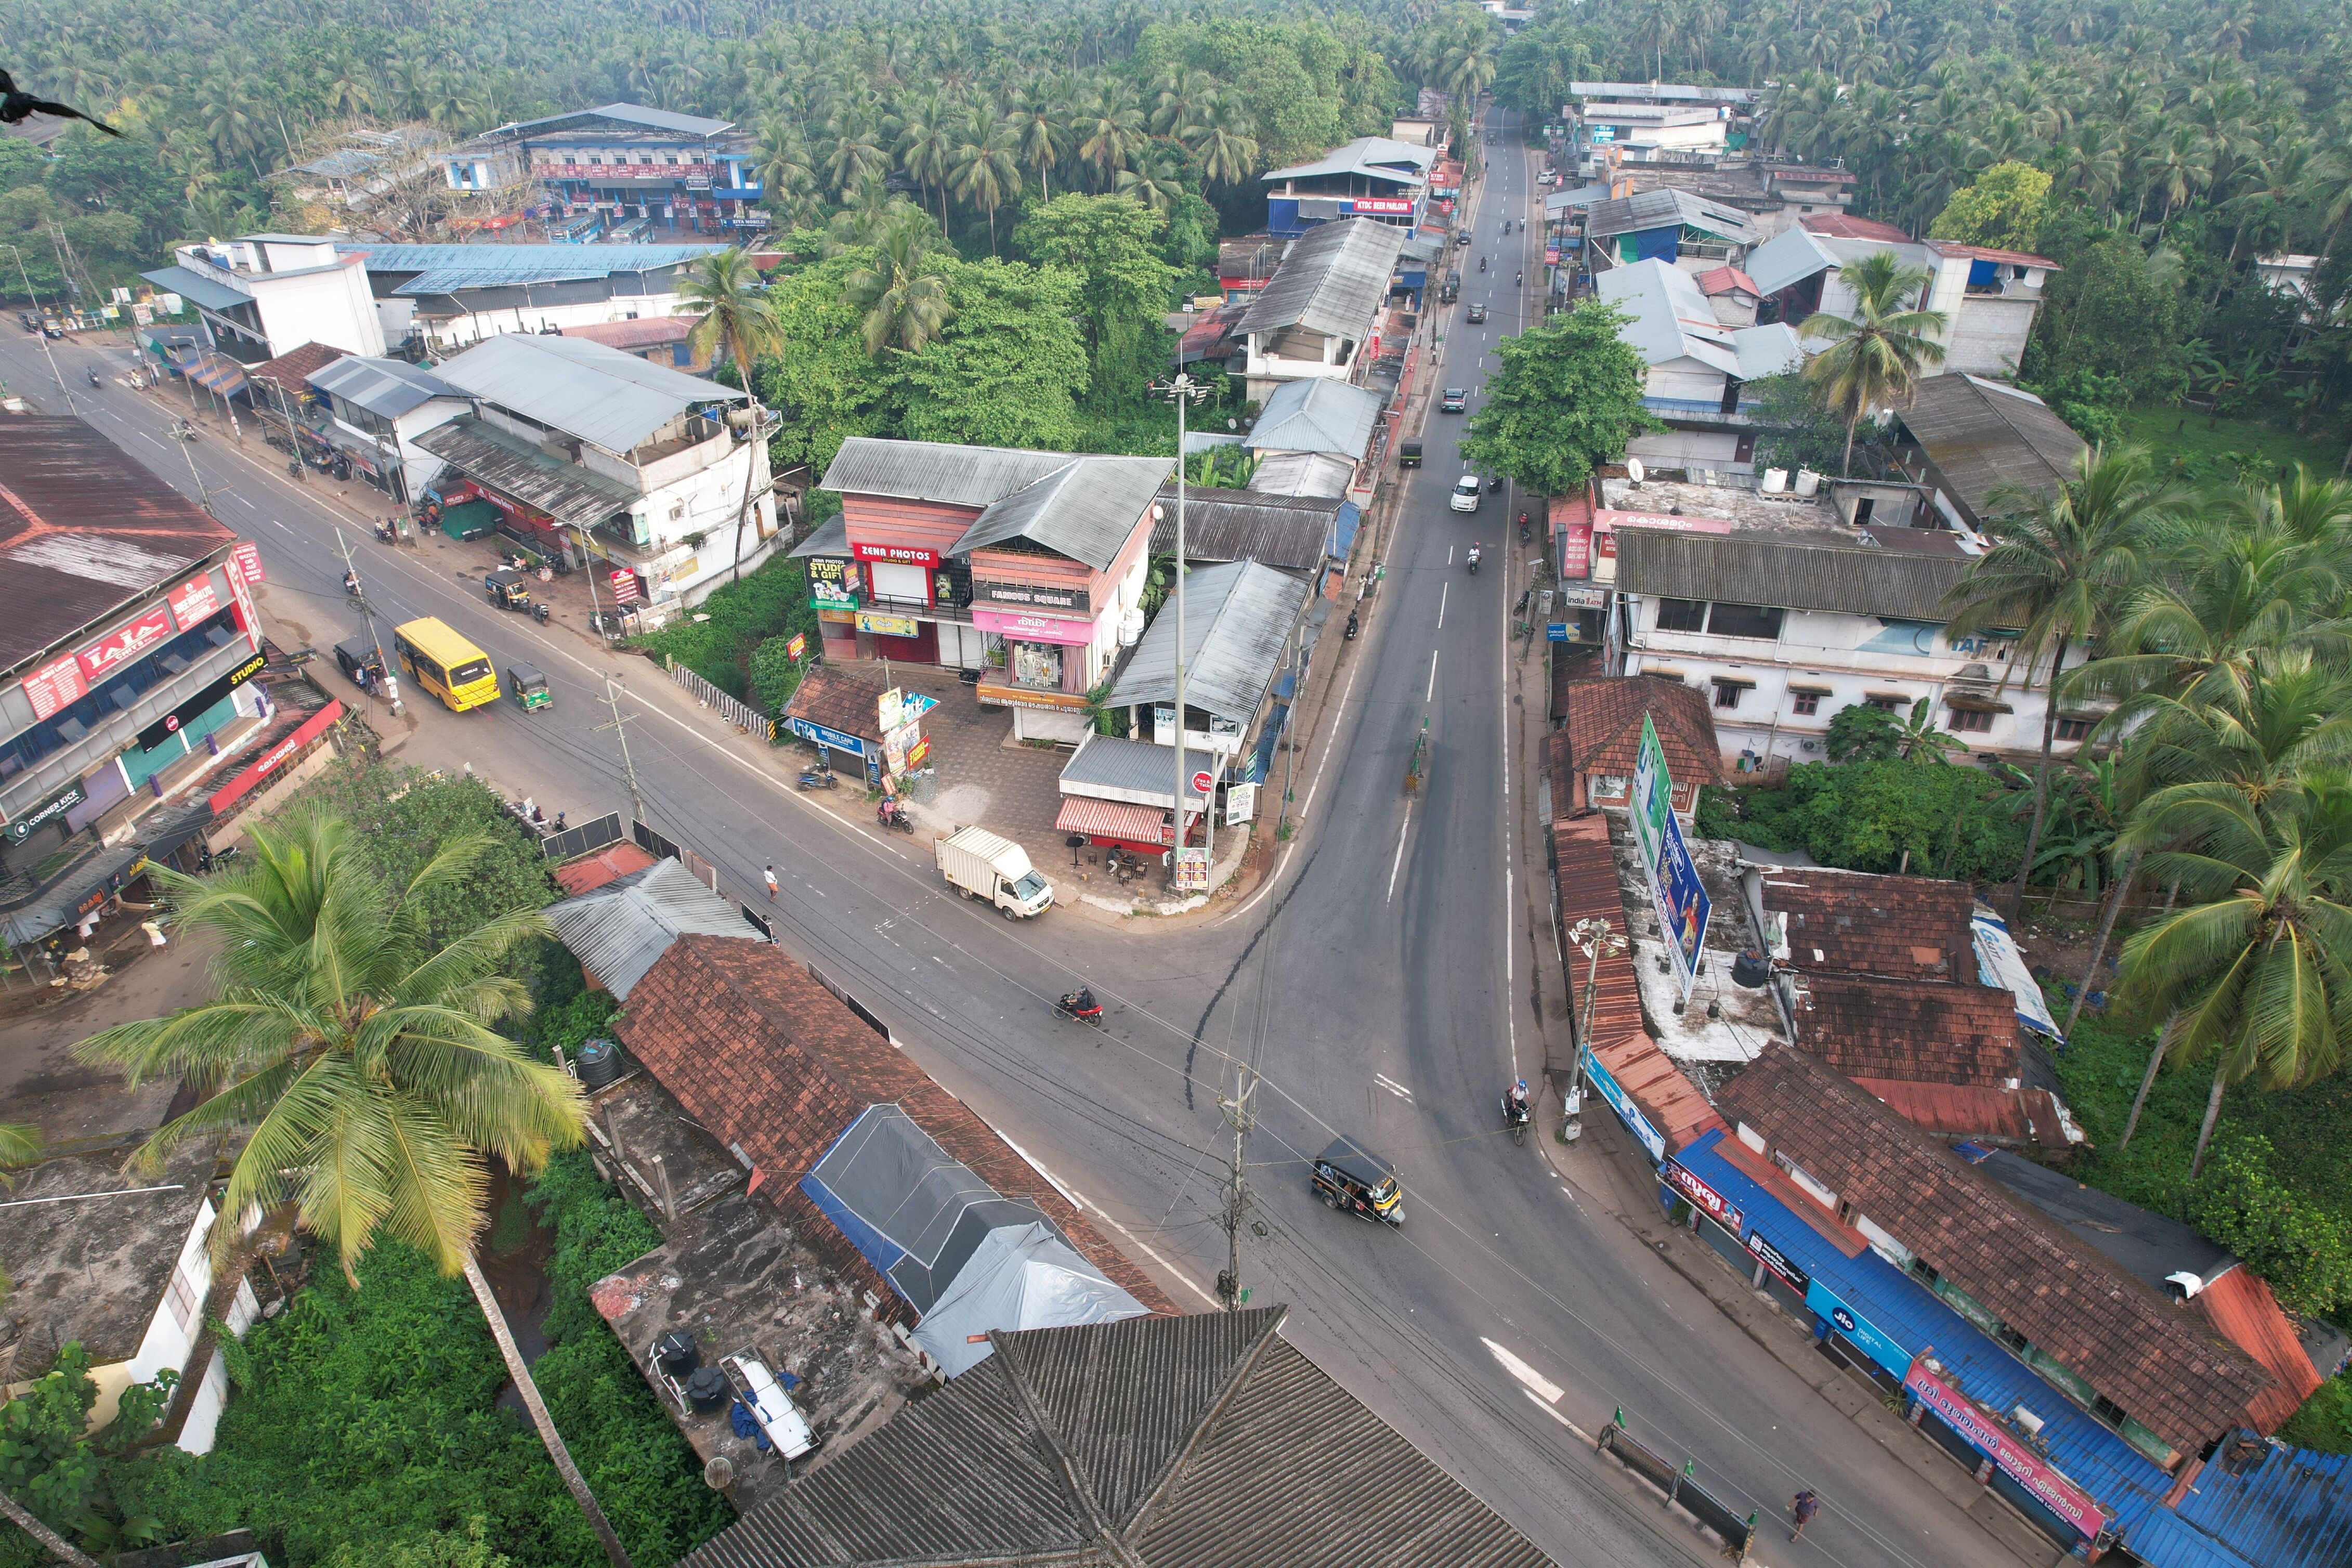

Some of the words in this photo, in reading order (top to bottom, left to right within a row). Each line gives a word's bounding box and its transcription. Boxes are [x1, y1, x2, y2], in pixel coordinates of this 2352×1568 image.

[1357, 201, 1372, 209] KTDC
[1387, 202, 1408, 211] PARLOUR
[861, 546, 886, 557] ZENA
[890, 548, 930, 561] PHOTOS
[173, 598, 190, 615] SREE
[187, 589, 205, 607] NIDHI
[991, 590, 1030, 602] FAMOUS
[1034, 594, 1072, 606] SQUARE
[1567, 596, 1585, 605] india
[115, 640, 144, 660] CHITS
[25, 677, 41, 689] SREE
[39, 668, 56, 682] NIDHI
[54, 657, 76, 673] LIMITED
[230, 657, 264, 685] STUDIO
[821, 729, 840, 741] MOBILE
[841, 735, 854, 746] CARE
[909, 741, 925, 761] STUDIO
[913, 749, 925, 764] FRAMES
[29, 802, 60, 826] CORNER
[59, 789, 78, 805] KICK
[1834, 1312, 1853, 1329] Jio
[1857, 1331, 1871, 1345] LIFE
[1858, 1327, 1883, 1350] DIGITAL
[1996, 1461, 2020, 1484] KERALA
[2020, 1481, 2045, 1504] SARKAR
[2044, 1500, 2069, 1523] LOTERY
